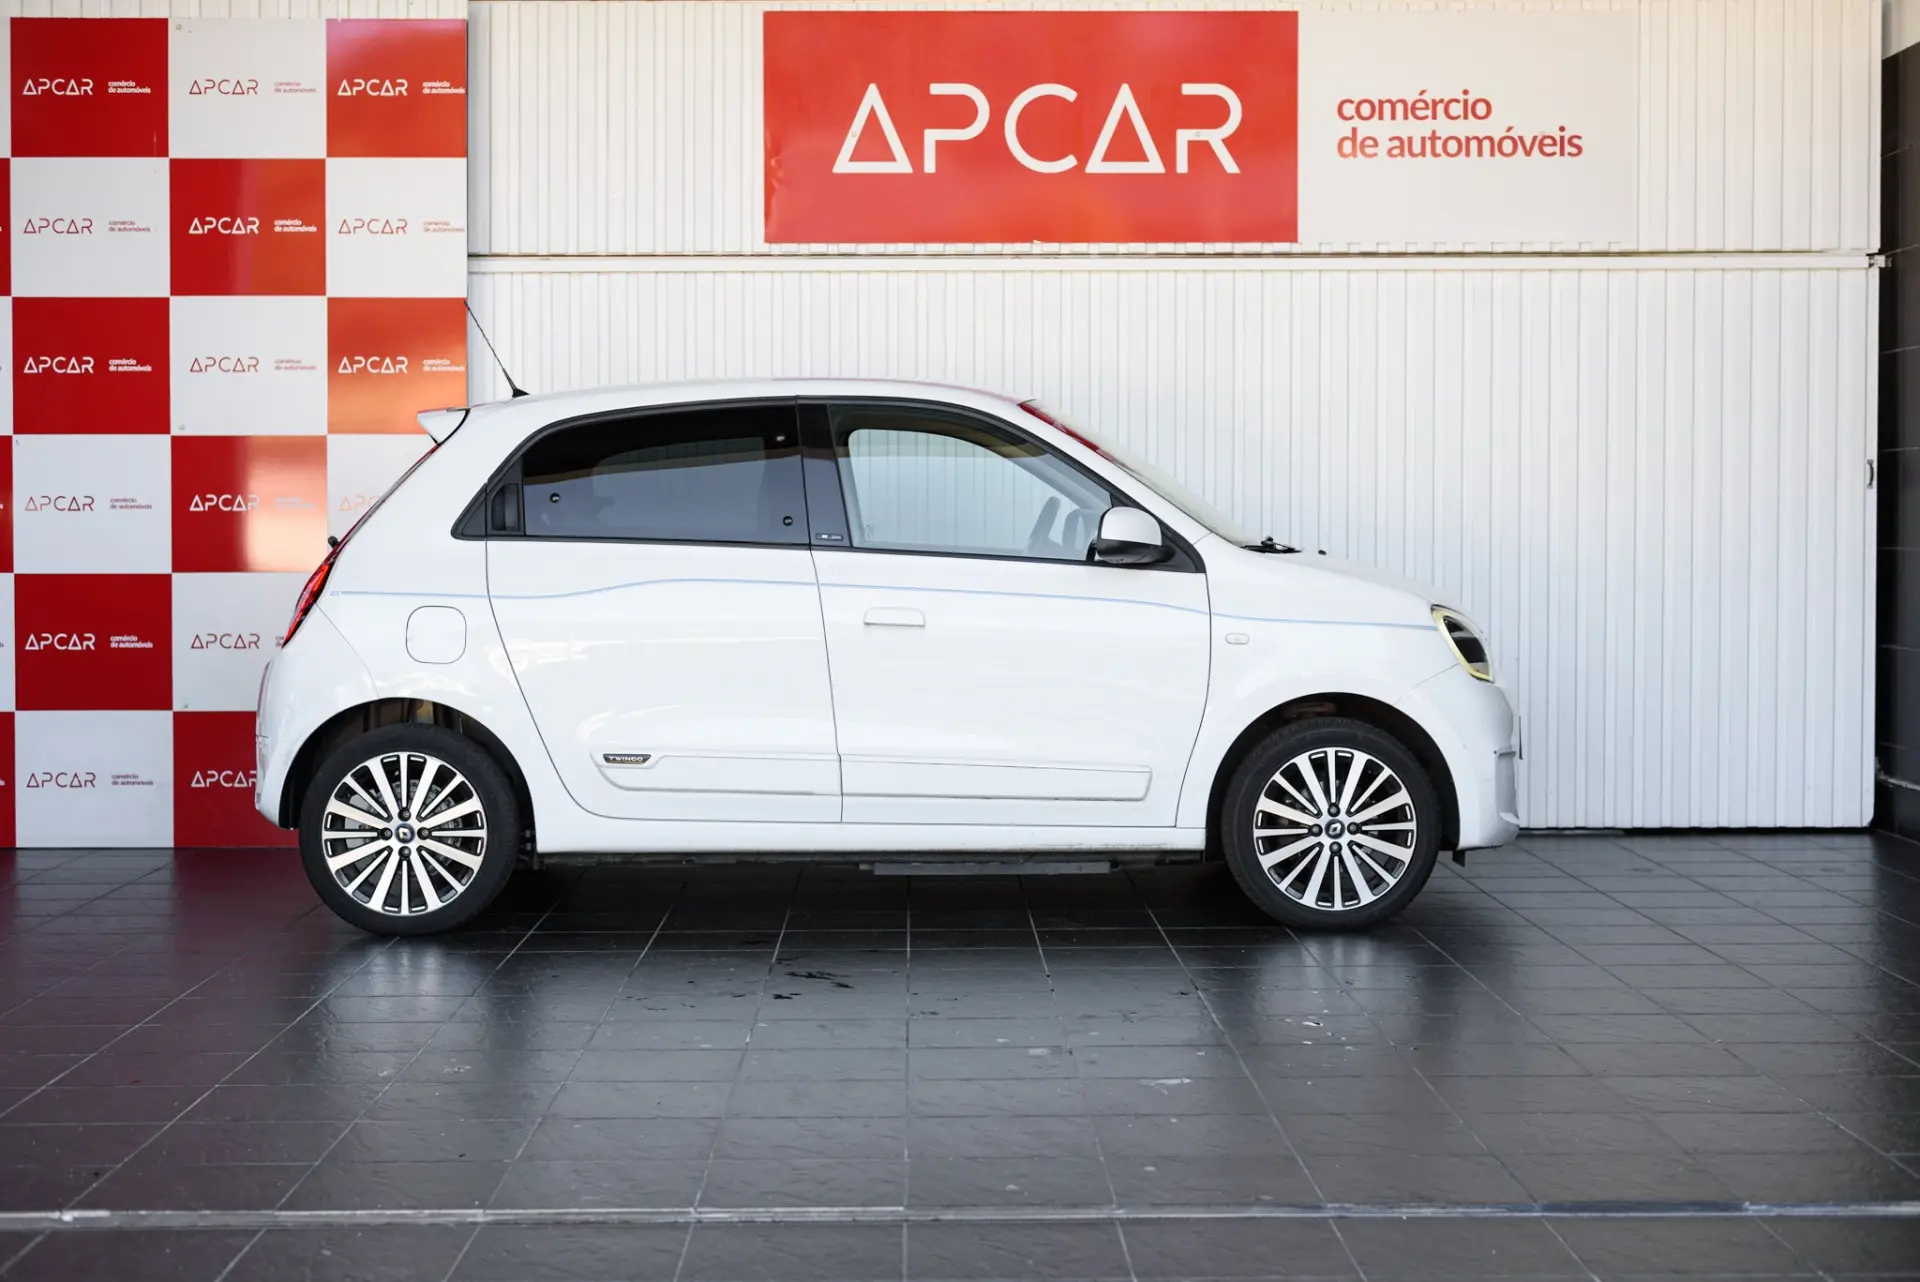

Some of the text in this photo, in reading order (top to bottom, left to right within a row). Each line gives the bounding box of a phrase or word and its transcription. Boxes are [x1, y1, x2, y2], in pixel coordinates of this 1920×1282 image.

[23, 78, 93, 96] APCAR
[188, 79, 259, 96] APCAR
[337, 78, 408, 96] APCAR
[1337, 89, 1492, 121] comércio
[832, 83, 1242, 174] APCAR
[1337, 126, 1583, 159] de automóveis
[23, 218, 93, 234] APCAR
[188, 217, 259, 234] APCAR
[338, 218, 408, 234] APCAR
[24, 356, 94, 374] APCAR
[189, 356, 259, 373] APCAR
[338, 356, 408, 374] APCAR
[24, 496, 94, 512] APCAR
[189, 494, 259, 512] APCAR
[25, 633, 95, 650] APCAR
[191, 634, 260, 649] APCAR
[26, 772, 96, 788] APCAR
[191, 770, 257, 788] APCAR
